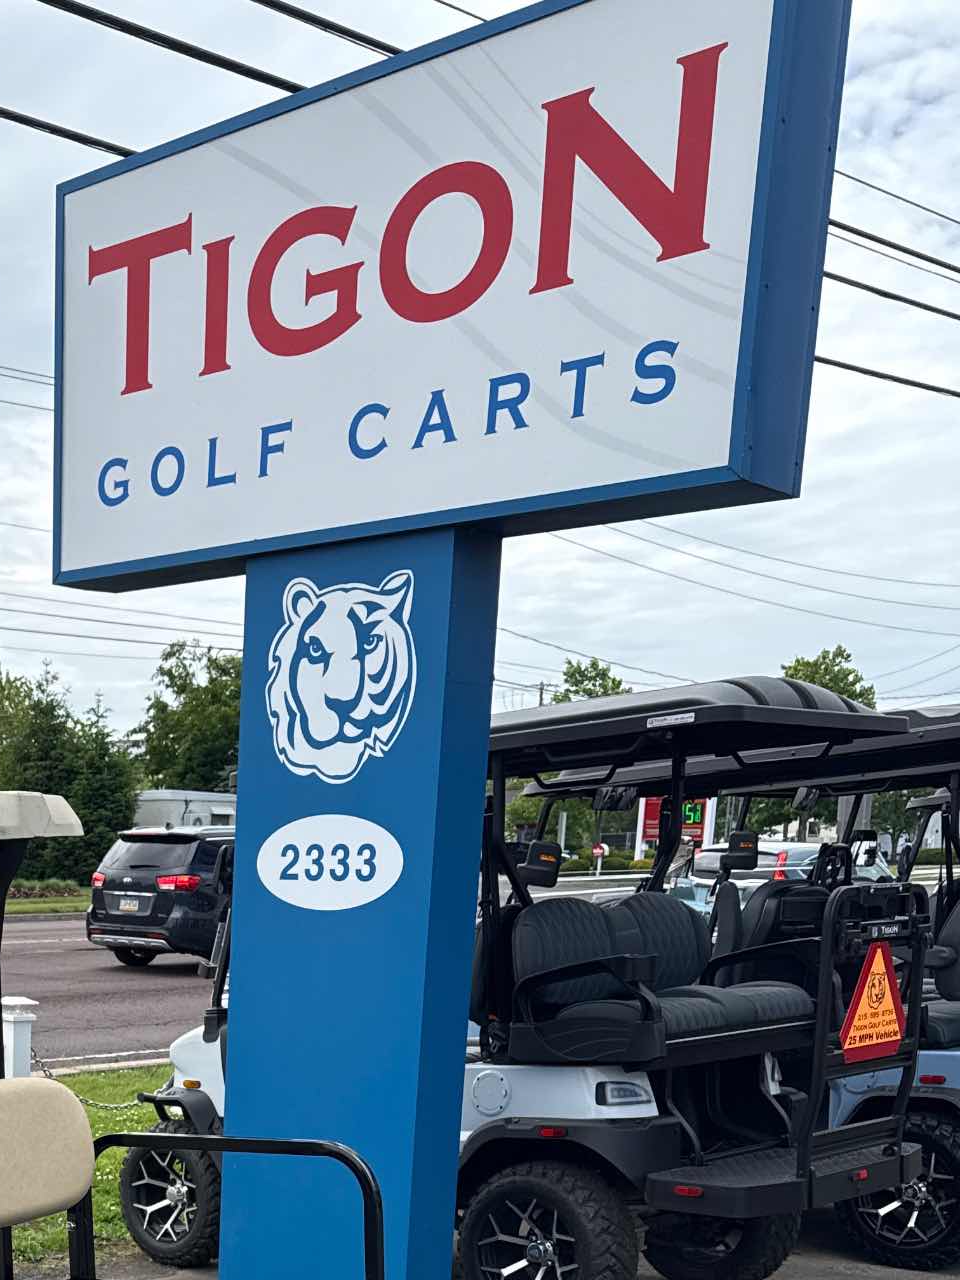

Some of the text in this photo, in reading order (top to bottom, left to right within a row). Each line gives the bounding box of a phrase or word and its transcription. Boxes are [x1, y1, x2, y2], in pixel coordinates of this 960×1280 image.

[88, 43, 727, 396] TIGON
[99, 341, 678, 507] GOLF CARTS
[280, 843, 377, 882] 2333
[848, 1028, 899, 1046] 25 MPH Vehicle
